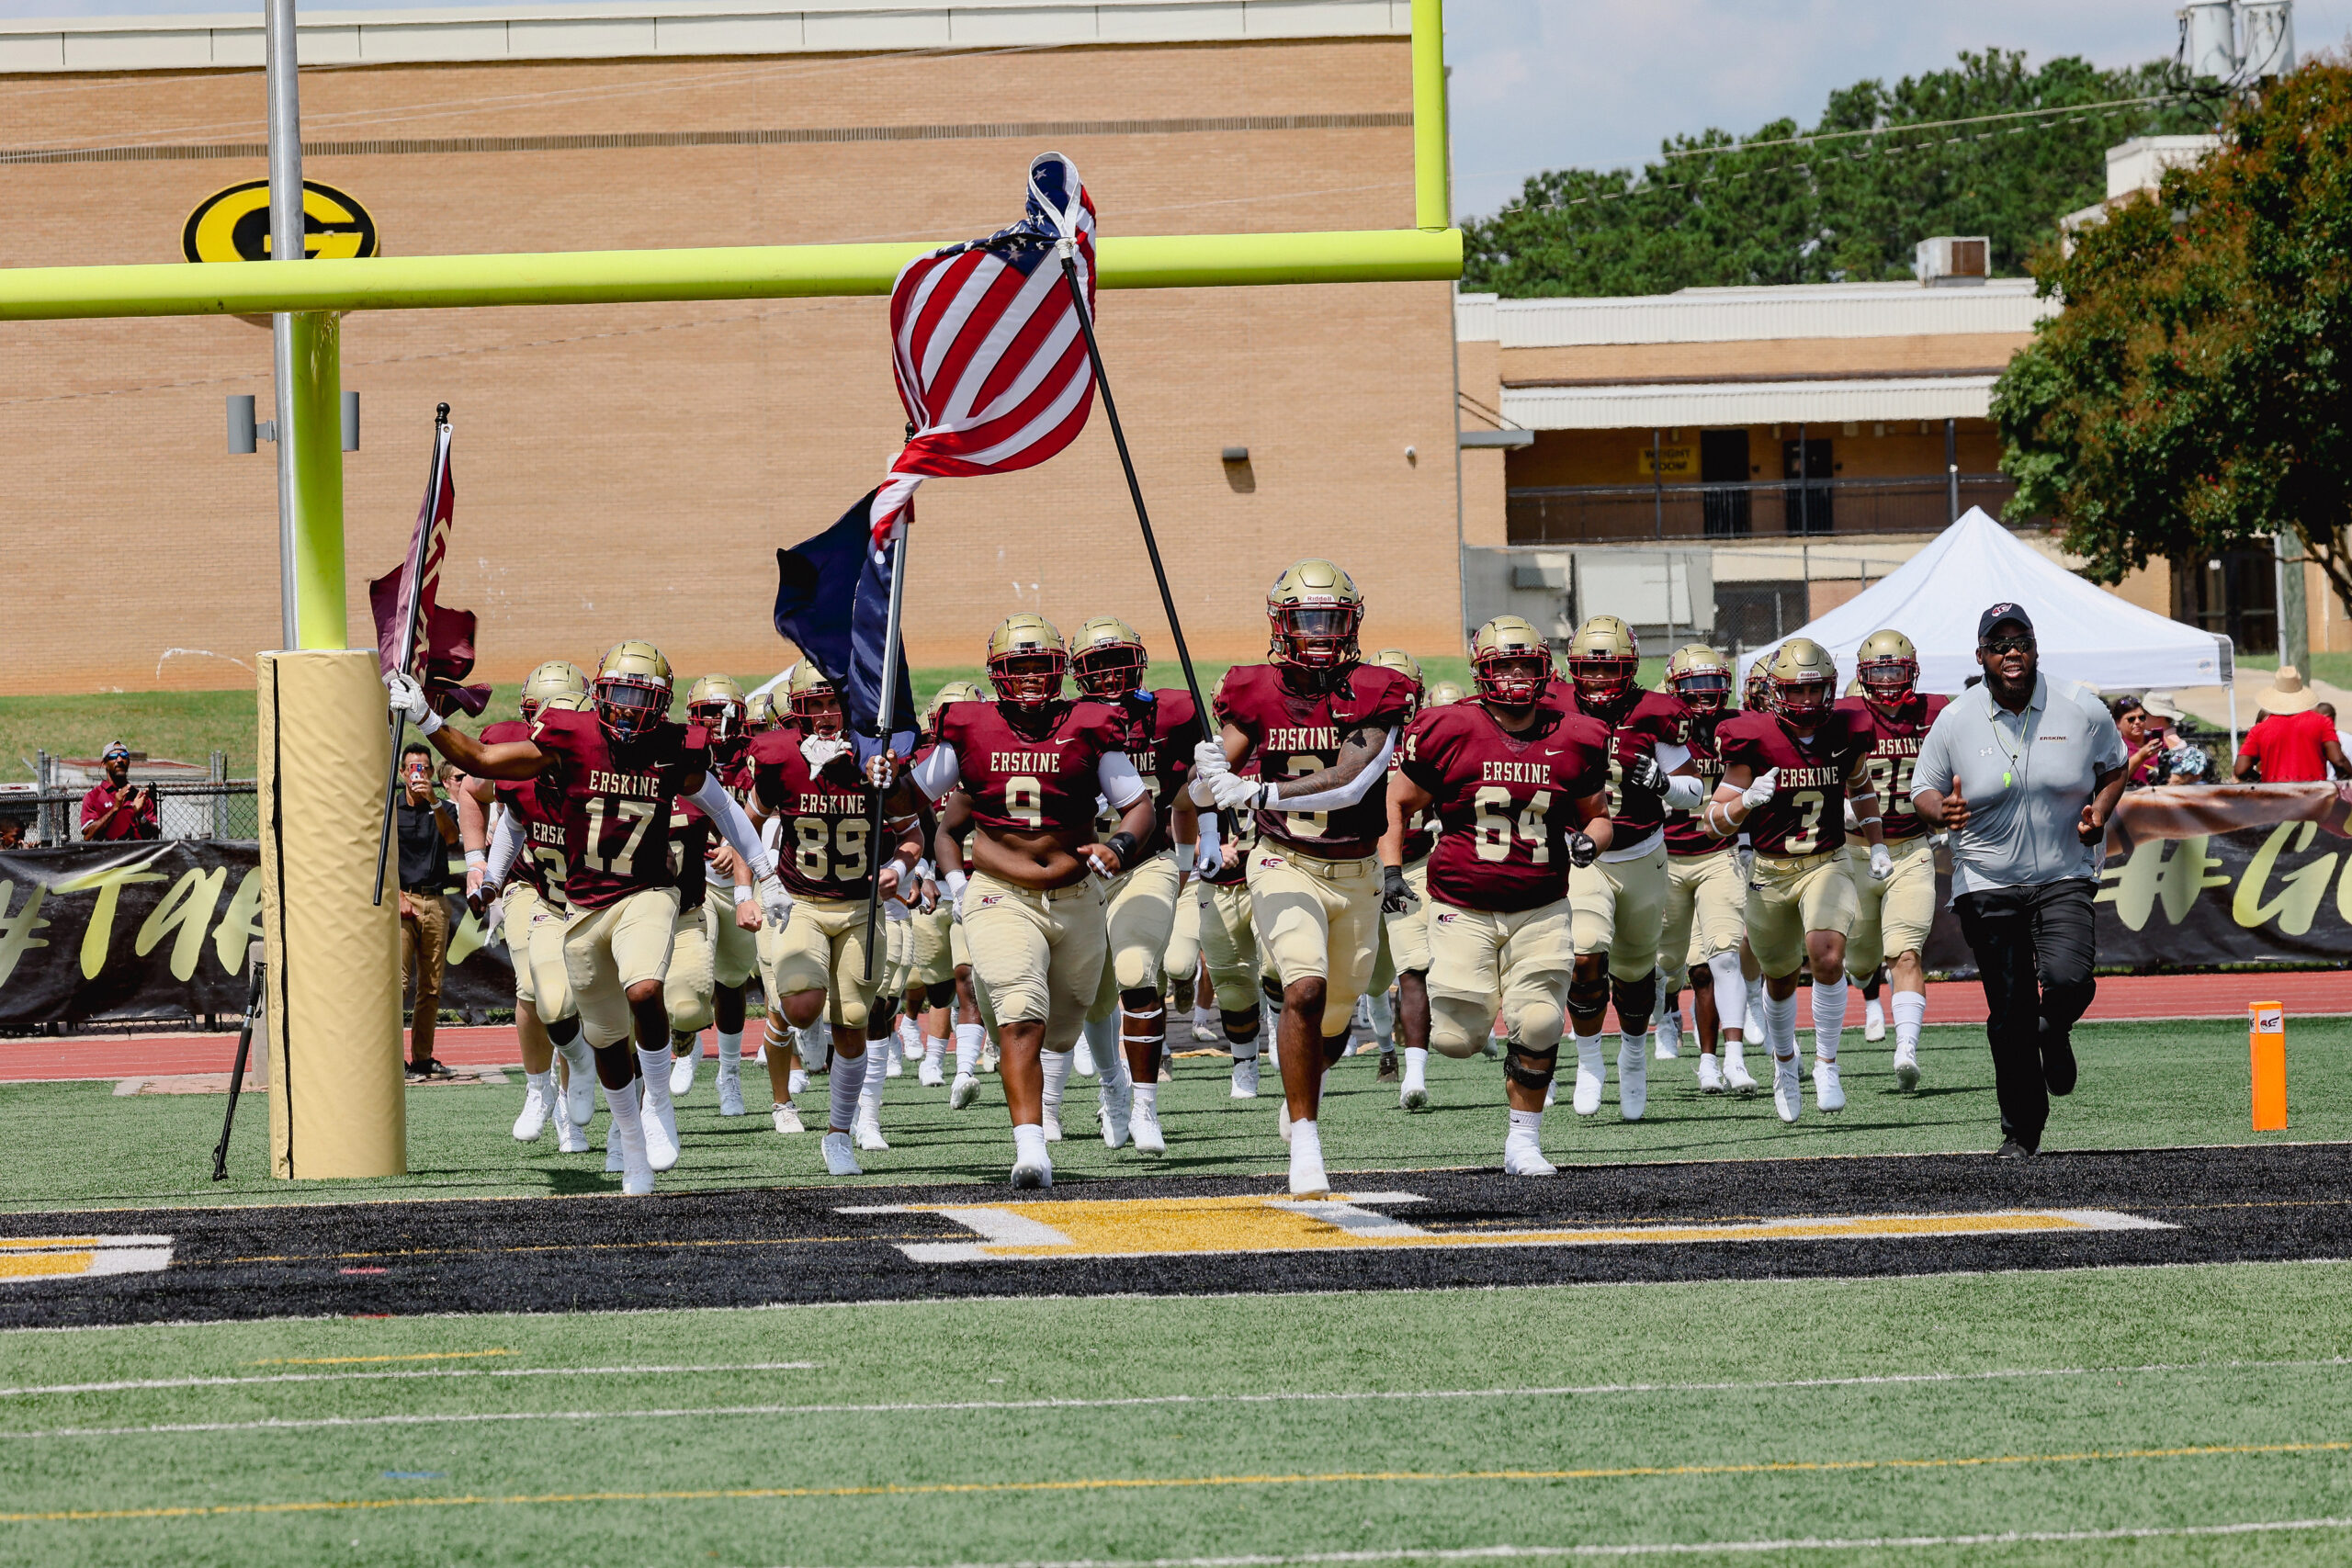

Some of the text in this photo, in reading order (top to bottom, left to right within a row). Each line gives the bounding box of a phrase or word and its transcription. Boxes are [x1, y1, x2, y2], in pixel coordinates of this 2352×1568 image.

[1267, 727, 1340, 750] ERSKINE
[990, 751, 1060, 773] ERSKINE
[1483, 761, 1551, 784] ERSKINE
[589, 770, 660, 798] ERSKINE
[1781, 766, 1838, 787] ERSKINE
[799, 793, 866, 815] ERSKINE
[533, 821, 566, 846] ERSK
[584, 796, 657, 874] 17
[1475, 785, 1552, 863] 64
[1784, 791, 1825, 854] 3
[793, 817, 871, 881] 89
